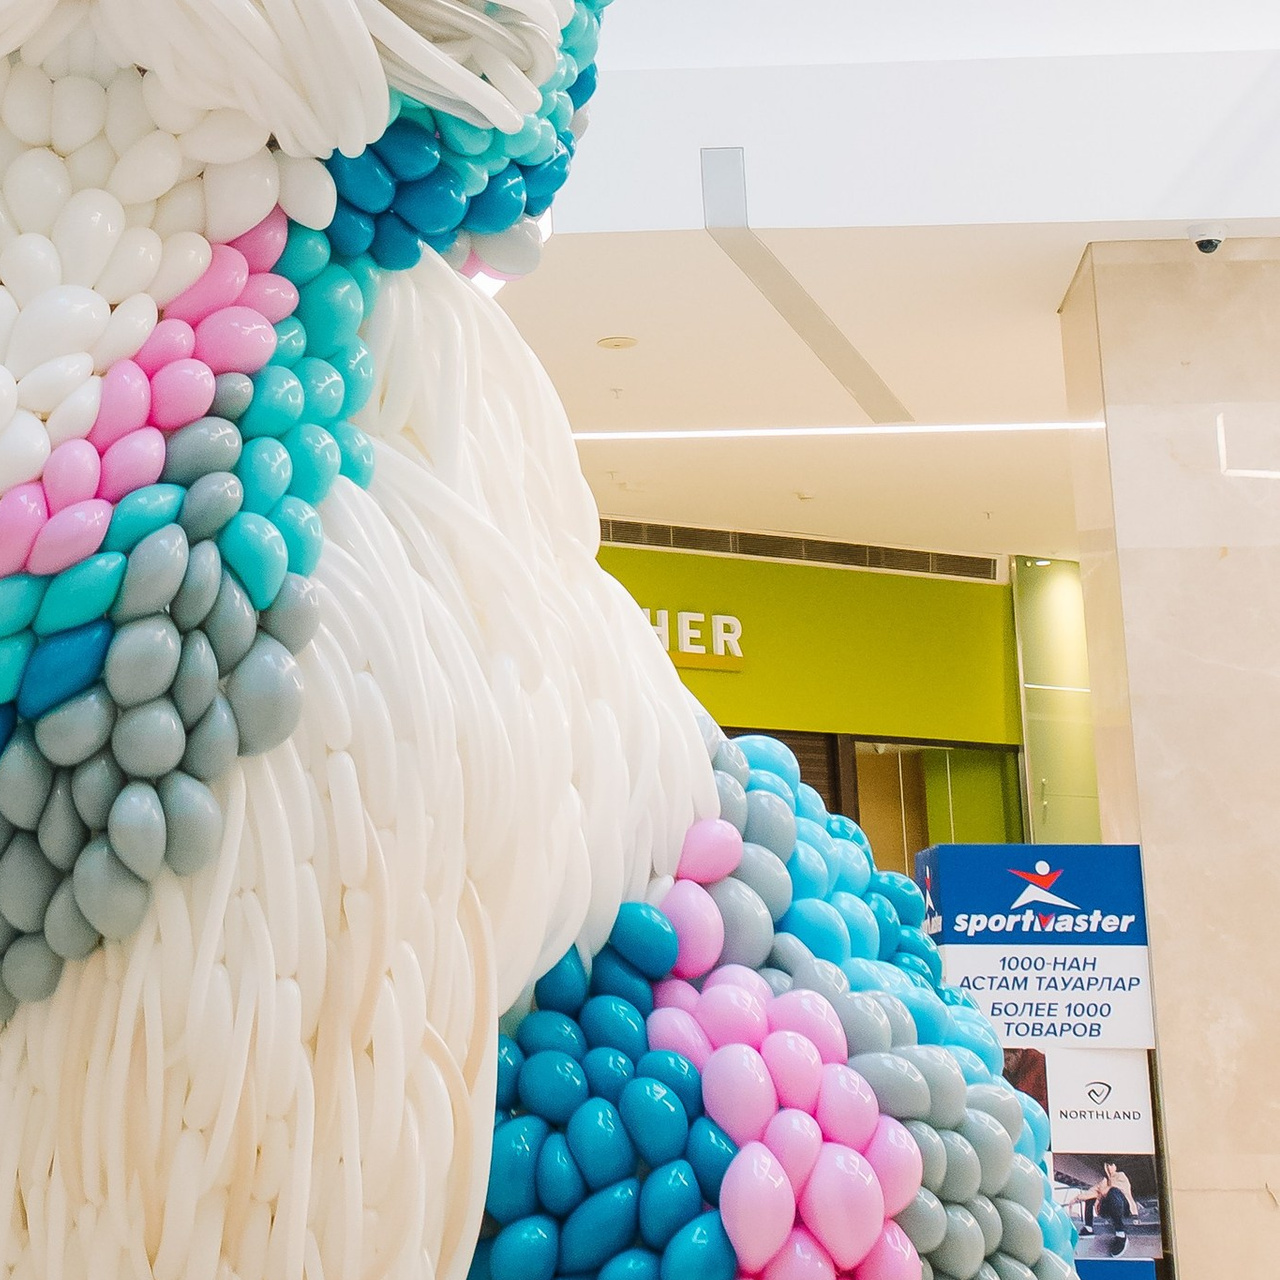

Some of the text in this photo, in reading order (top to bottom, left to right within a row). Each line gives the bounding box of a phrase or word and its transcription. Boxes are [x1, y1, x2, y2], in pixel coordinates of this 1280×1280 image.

[953, 909, 1135, 937] sportmaster
[999, 956, 1097, 971] 1000-НАН
[959, 976, 1141, 992] АСТАМ ТАУАРЛАР
[990, 1002, 1111, 1017] БОЛЕЕ 1000
[1004, 1022, 1102, 1037] ТОВАРОВ
[1060, 1110, 1141, 1121] NORTHLAND
